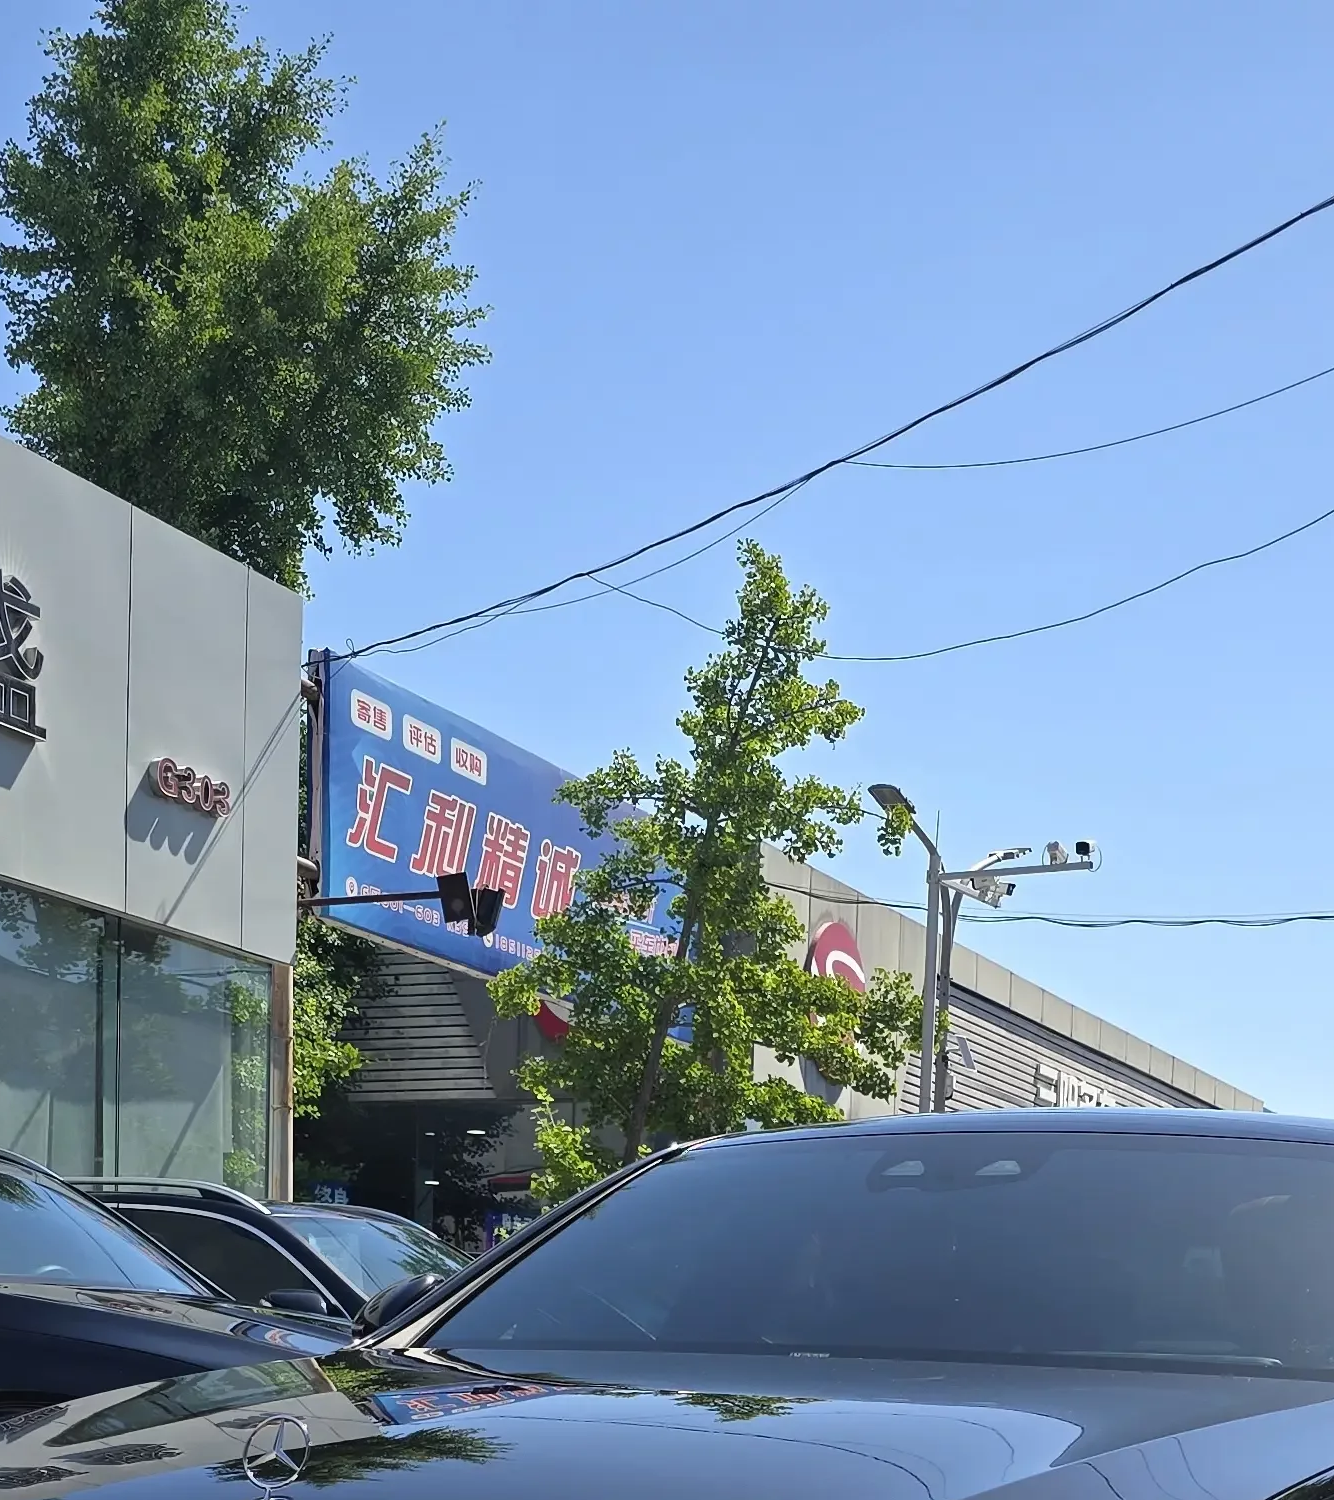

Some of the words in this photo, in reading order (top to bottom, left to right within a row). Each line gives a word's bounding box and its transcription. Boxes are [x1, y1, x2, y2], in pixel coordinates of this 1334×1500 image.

[357, 698, 387, 732] 寄售
[409, 723, 437, 756] 评估
[455, 747, 482, 777] 收购
[155, 757, 232, 818] G303
[347, 756, 581, 919] 汇利精诚
